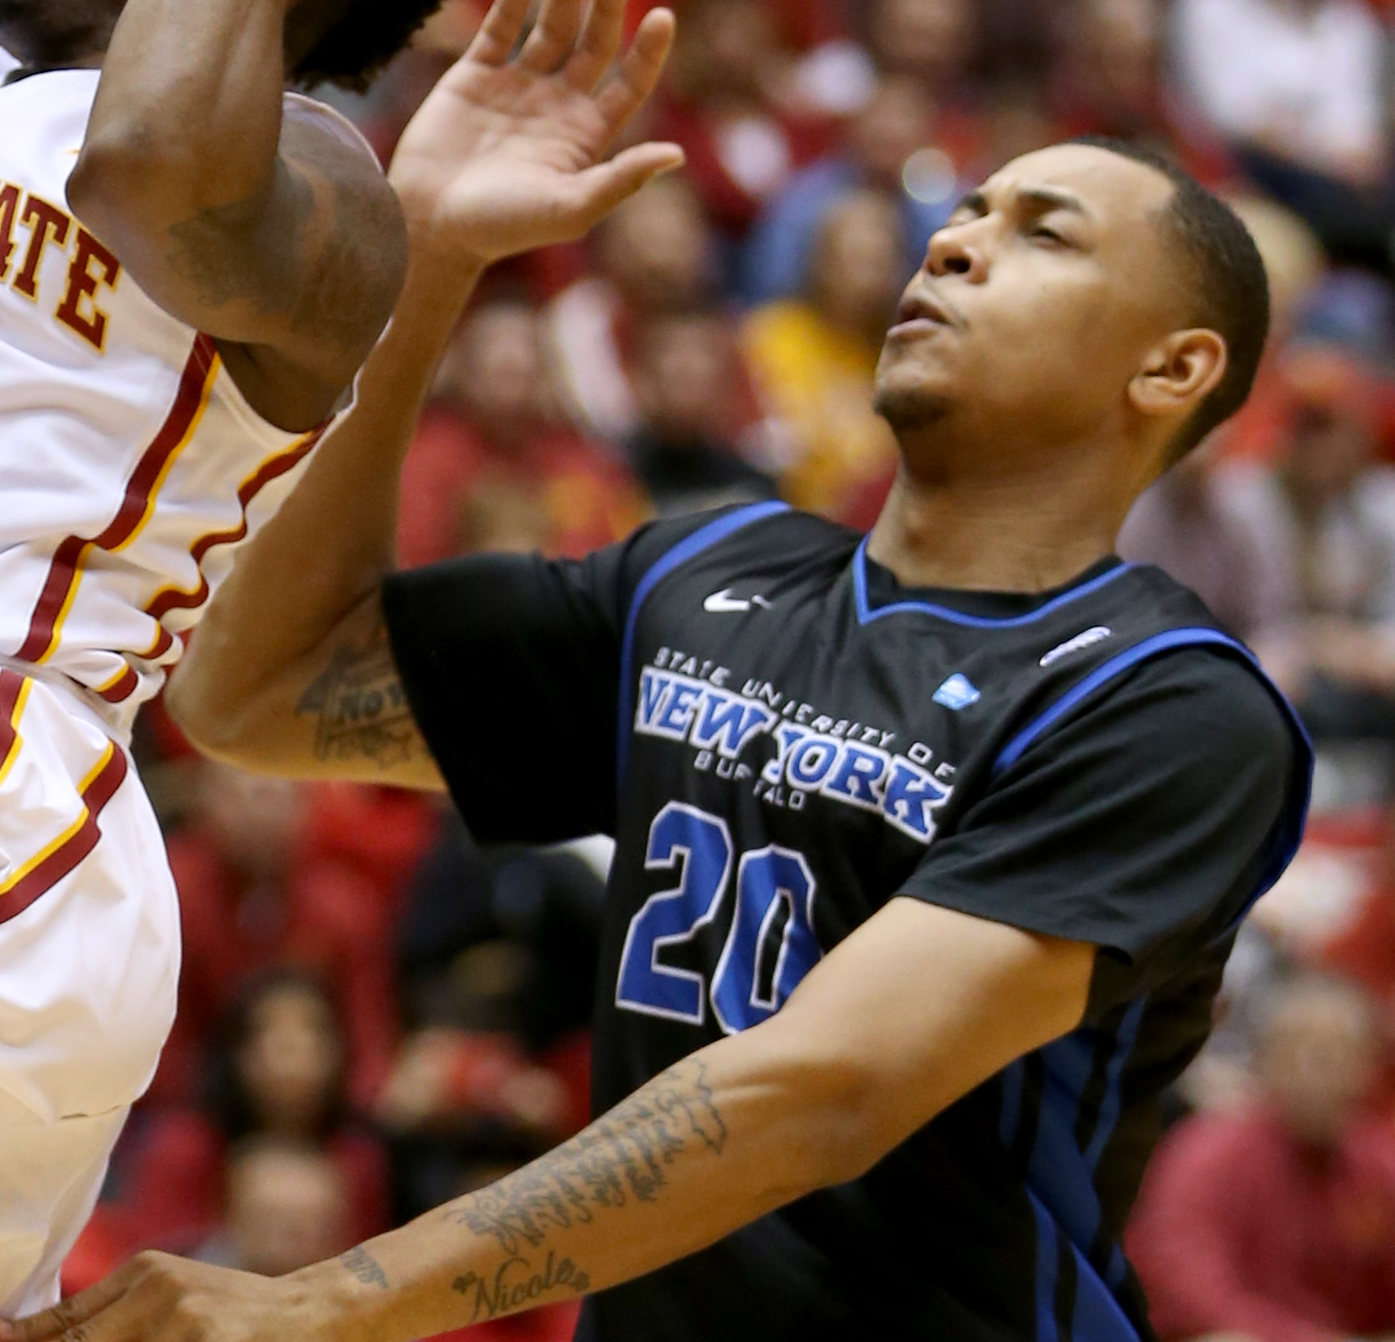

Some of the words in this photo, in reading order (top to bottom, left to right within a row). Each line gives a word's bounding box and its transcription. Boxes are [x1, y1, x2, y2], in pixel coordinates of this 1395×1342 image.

[634, 664, 779, 759] NEW
[762, 721, 955, 846] YORK
[907, 741, 956, 778] OF
[615, 799, 825, 1036] 20
[470, 1250, 576, 1321] Nicole
